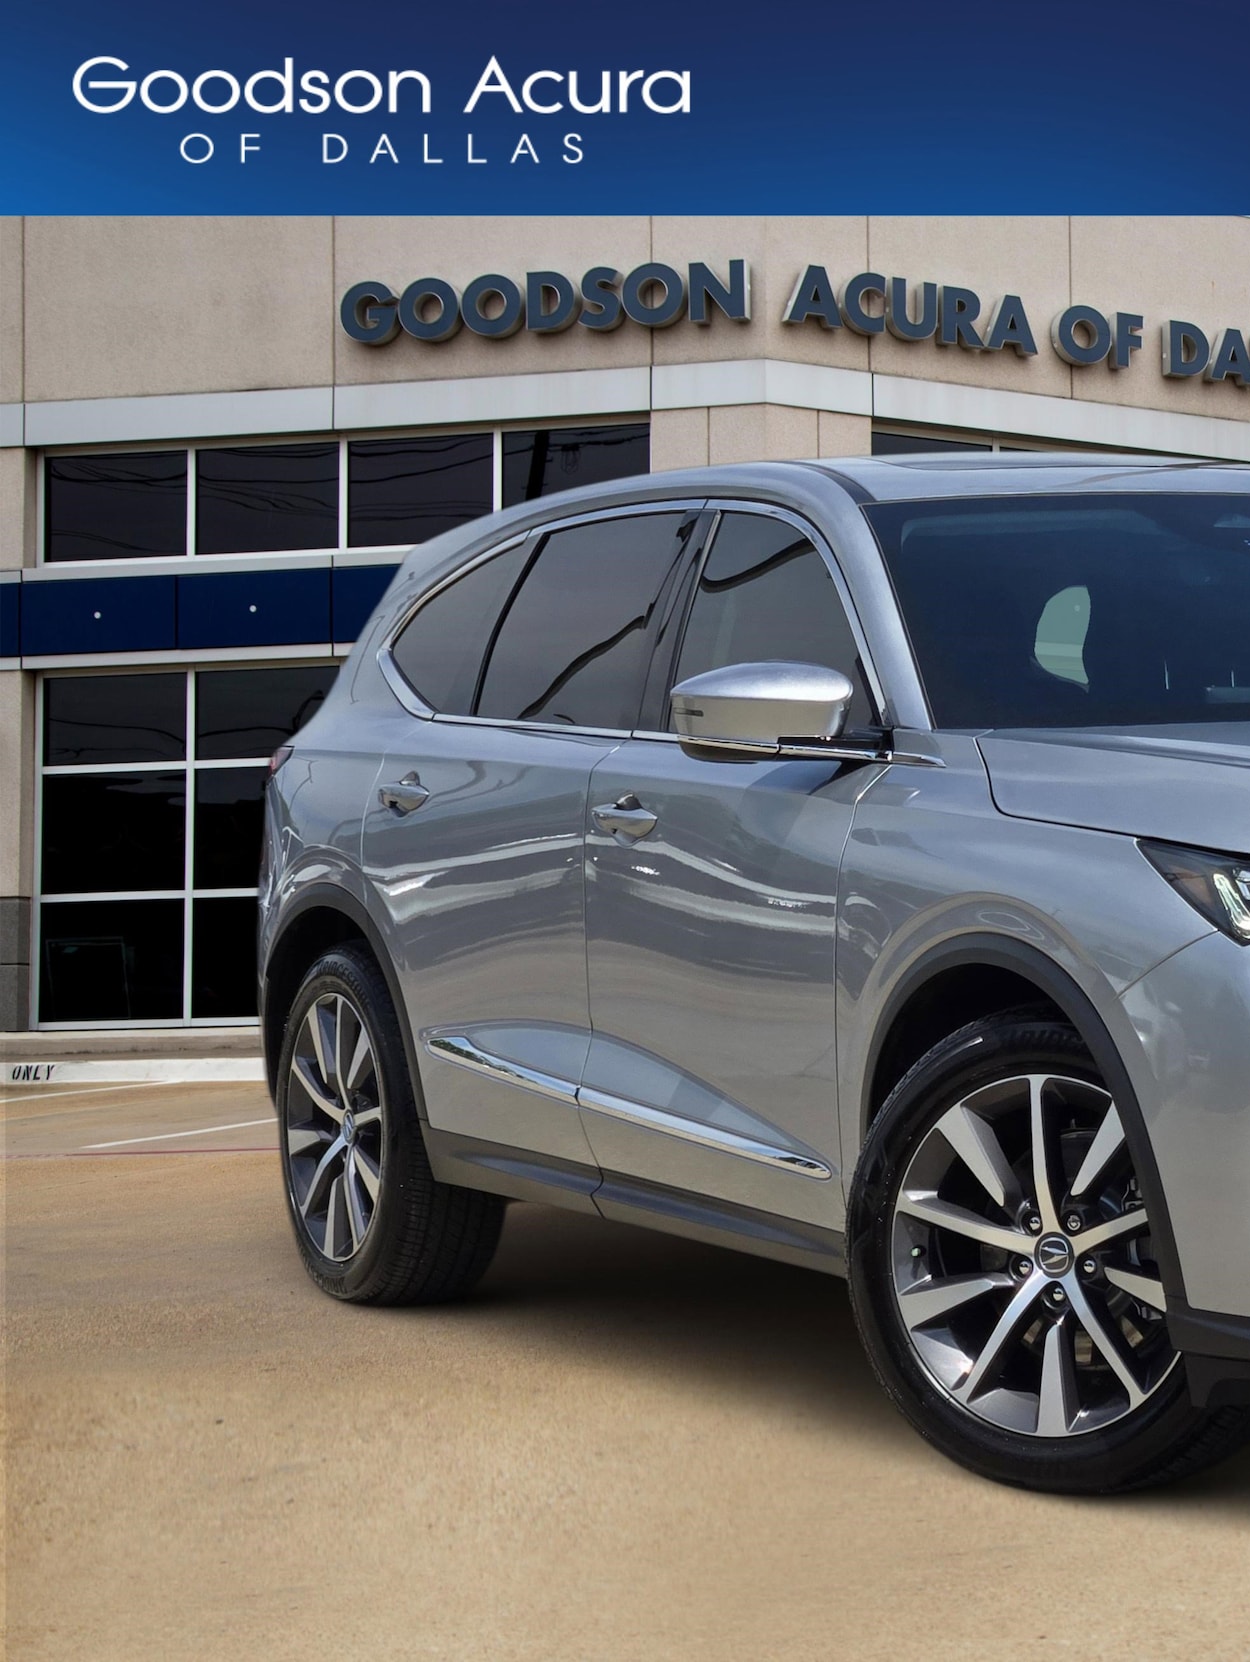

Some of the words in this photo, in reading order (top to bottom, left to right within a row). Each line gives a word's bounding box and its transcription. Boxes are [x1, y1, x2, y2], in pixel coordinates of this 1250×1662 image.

[340, 259, 752, 346] GOODSON
[782, 264, 1038, 356] ACURA
[1051, 304, 1144, 369] OF
[12, 1065, 55, 1080] ONLY
